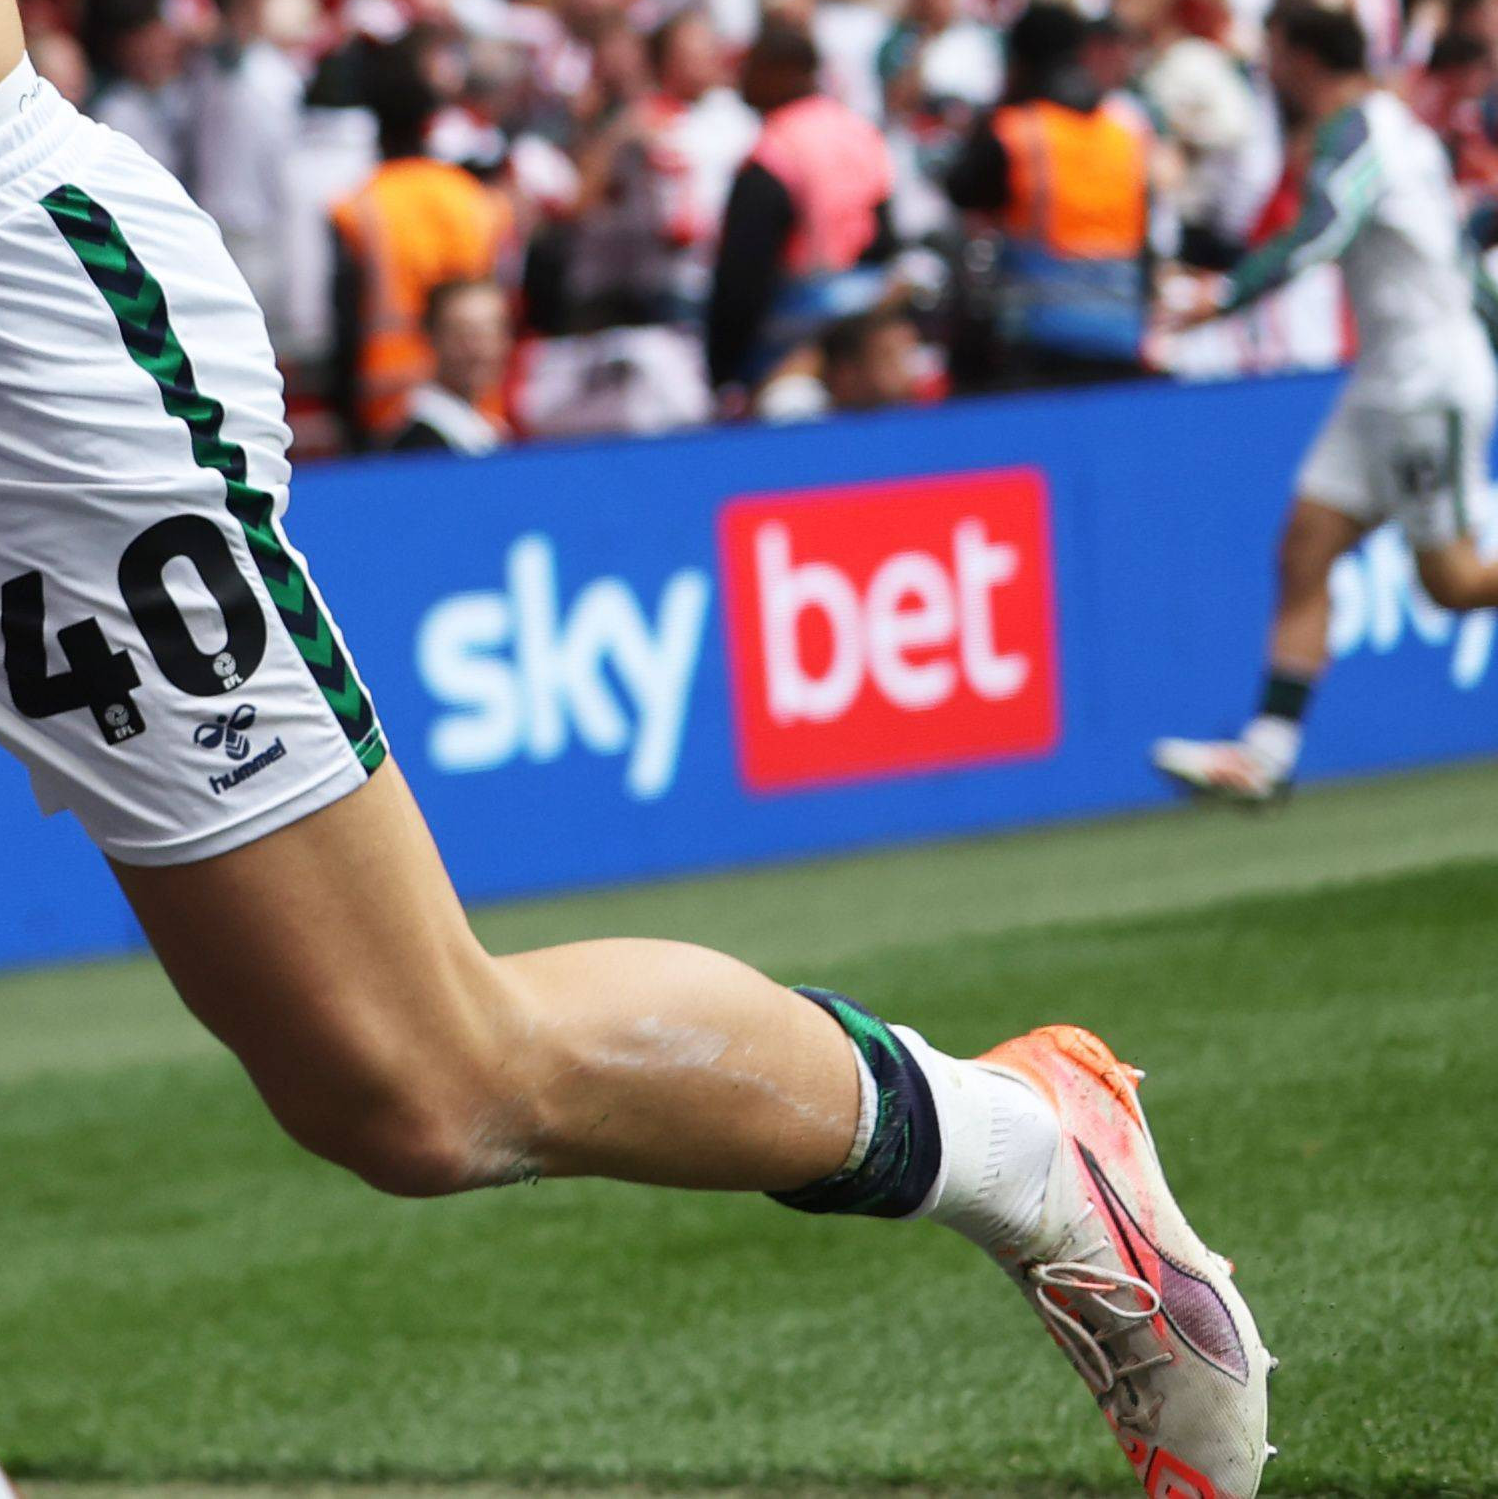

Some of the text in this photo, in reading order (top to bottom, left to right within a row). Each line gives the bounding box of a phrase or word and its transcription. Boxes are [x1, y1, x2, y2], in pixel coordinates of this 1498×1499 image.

[0, 513, 267, 746] 40
[416, 515, 1030, 801] sky bet
[223, 672, 244, 690] EFL
[115, 725, 136, 739] EFL
[209, 735, 287, 795] hummel
